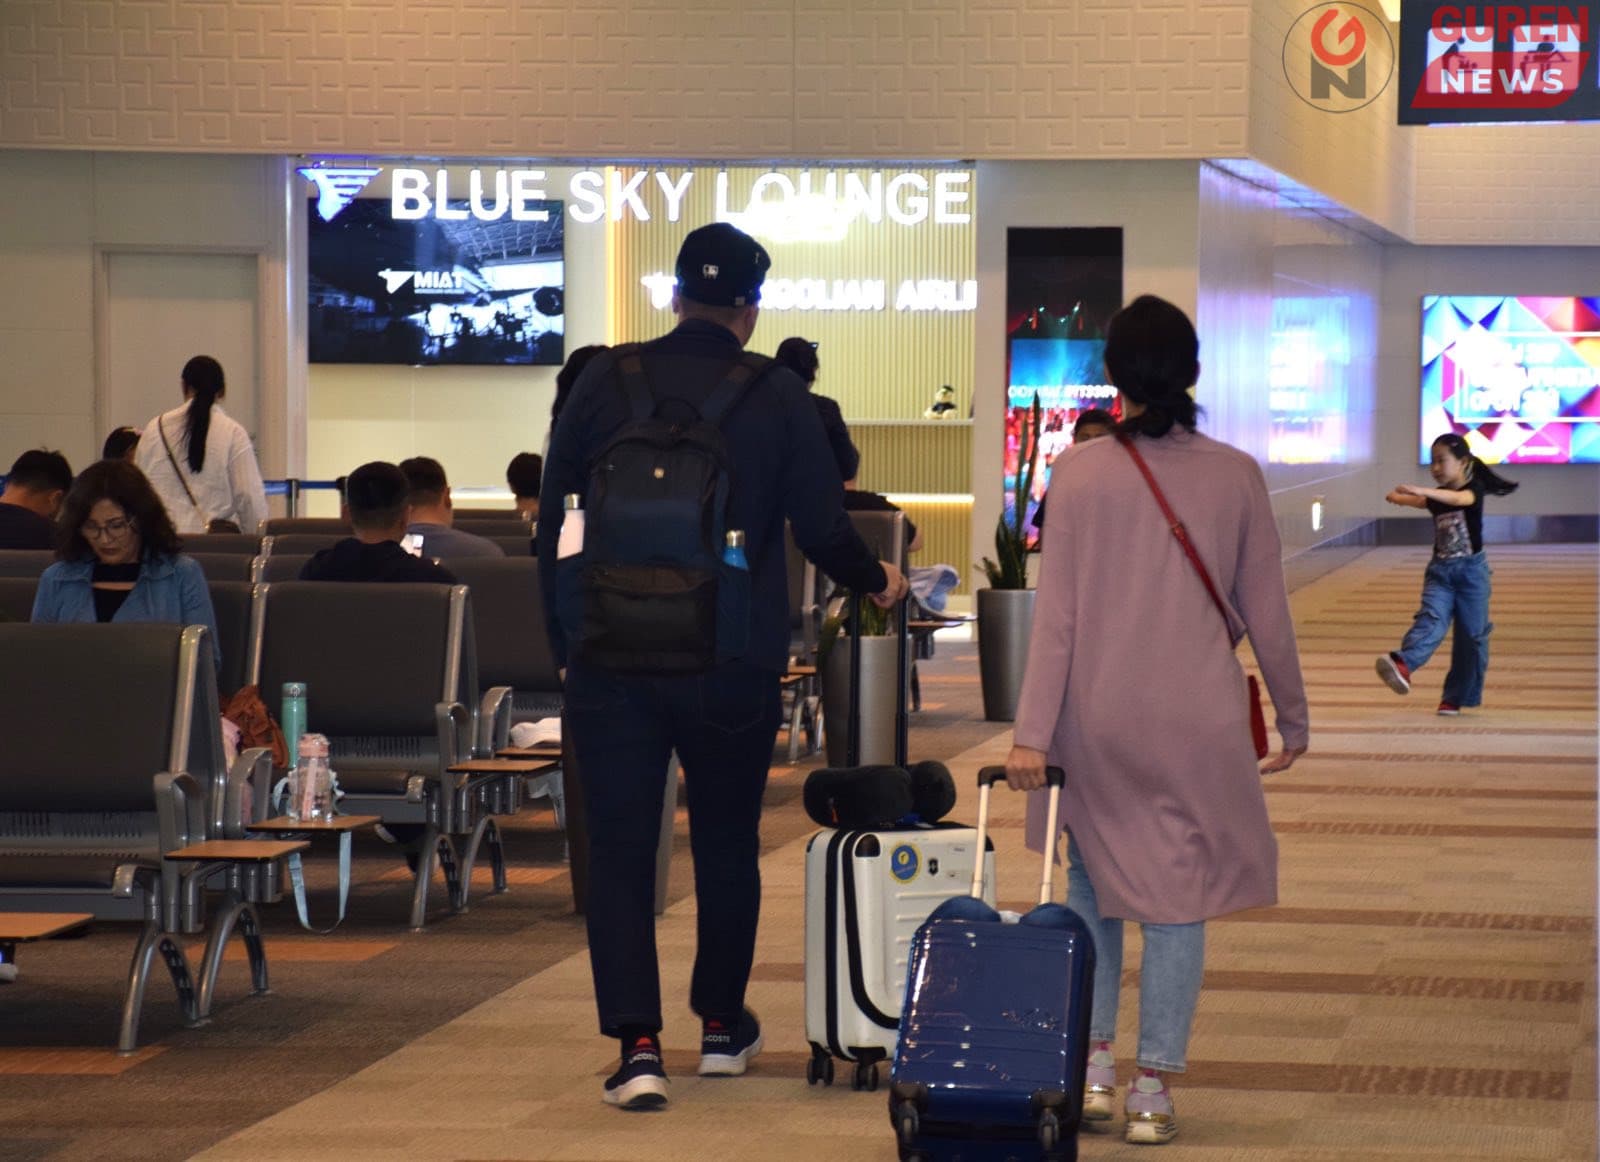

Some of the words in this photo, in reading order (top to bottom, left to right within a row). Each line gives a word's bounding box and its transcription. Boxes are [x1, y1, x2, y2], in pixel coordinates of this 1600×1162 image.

[391, 168, 549, 222] BLUE
[568, 169, 694, 224] SKY
[715, 171, 971, 226] LOUNGE
[414, 271, 464, 288] MIAT
